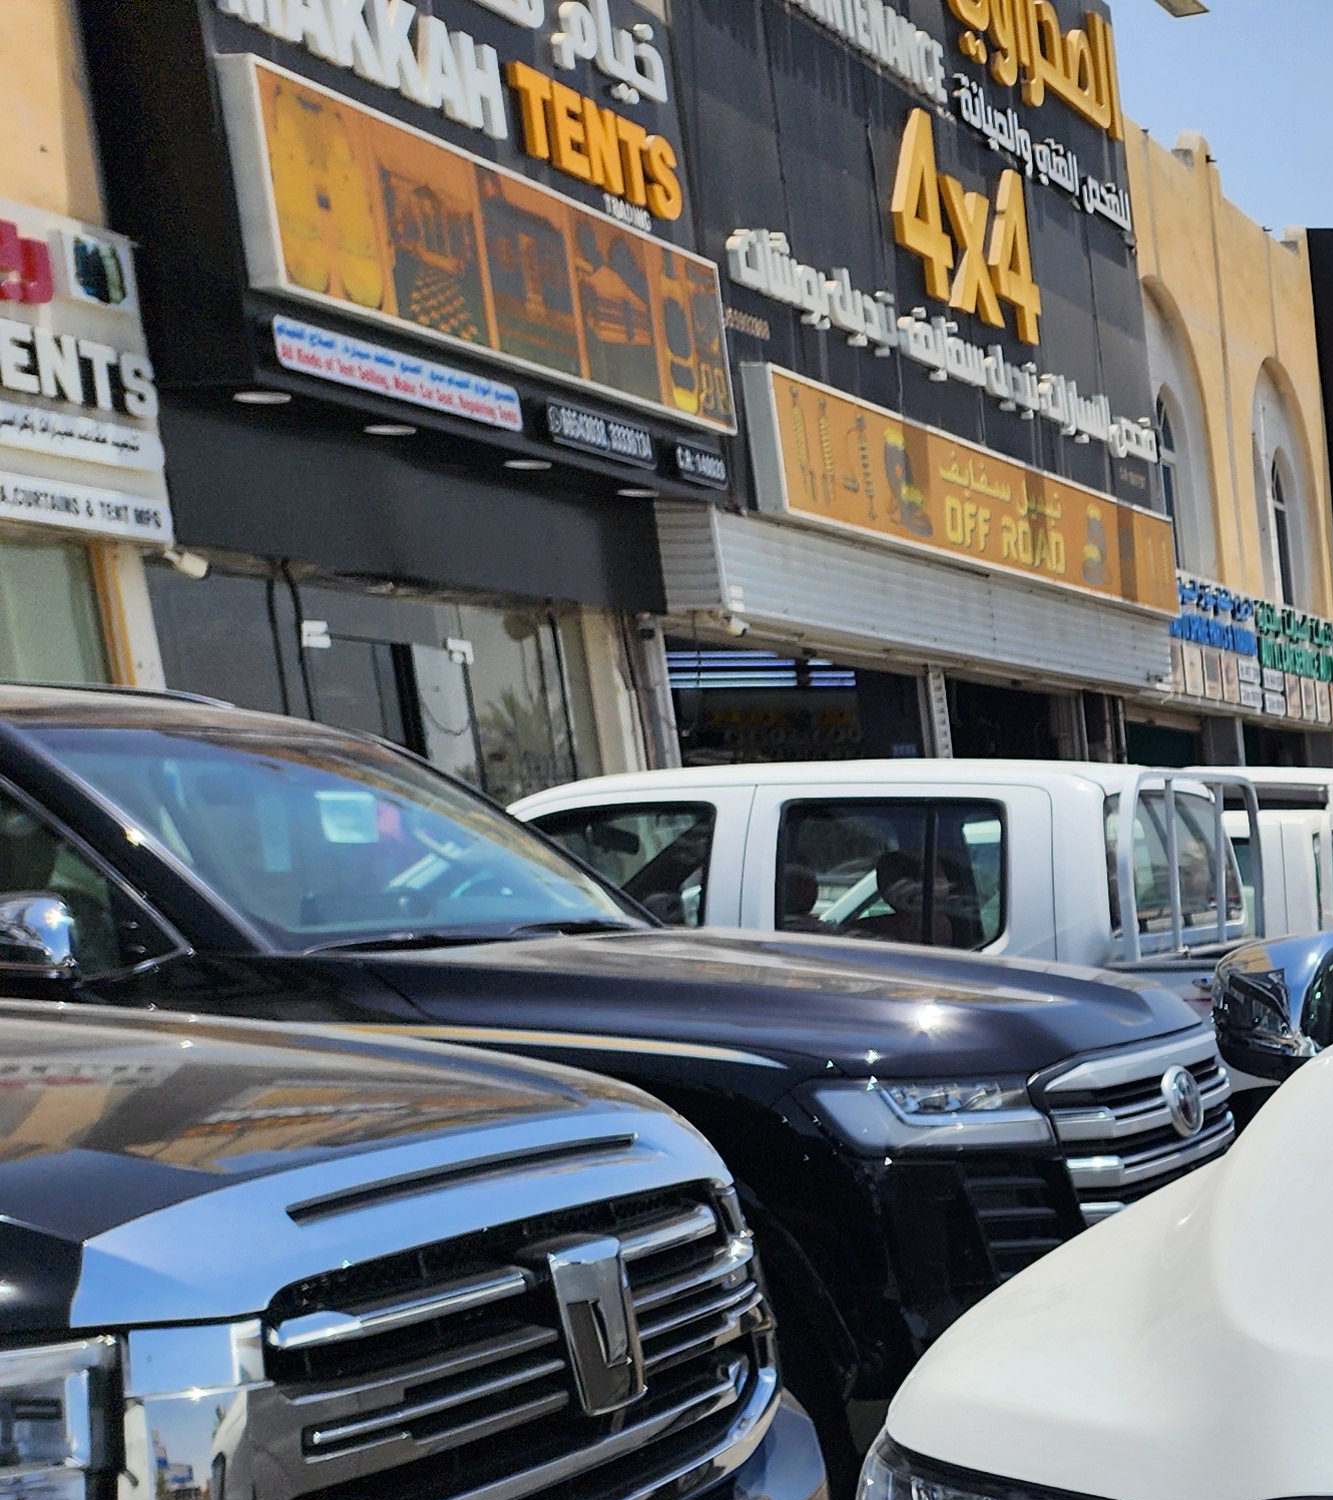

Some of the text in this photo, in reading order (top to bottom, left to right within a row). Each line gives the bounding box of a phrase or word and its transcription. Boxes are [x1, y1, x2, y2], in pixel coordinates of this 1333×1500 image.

[507, 60, 683, 220] TENTS
[891, 107, 1041, 346] 4x4
[945, 494, 1067, 575] OFF ROAD
